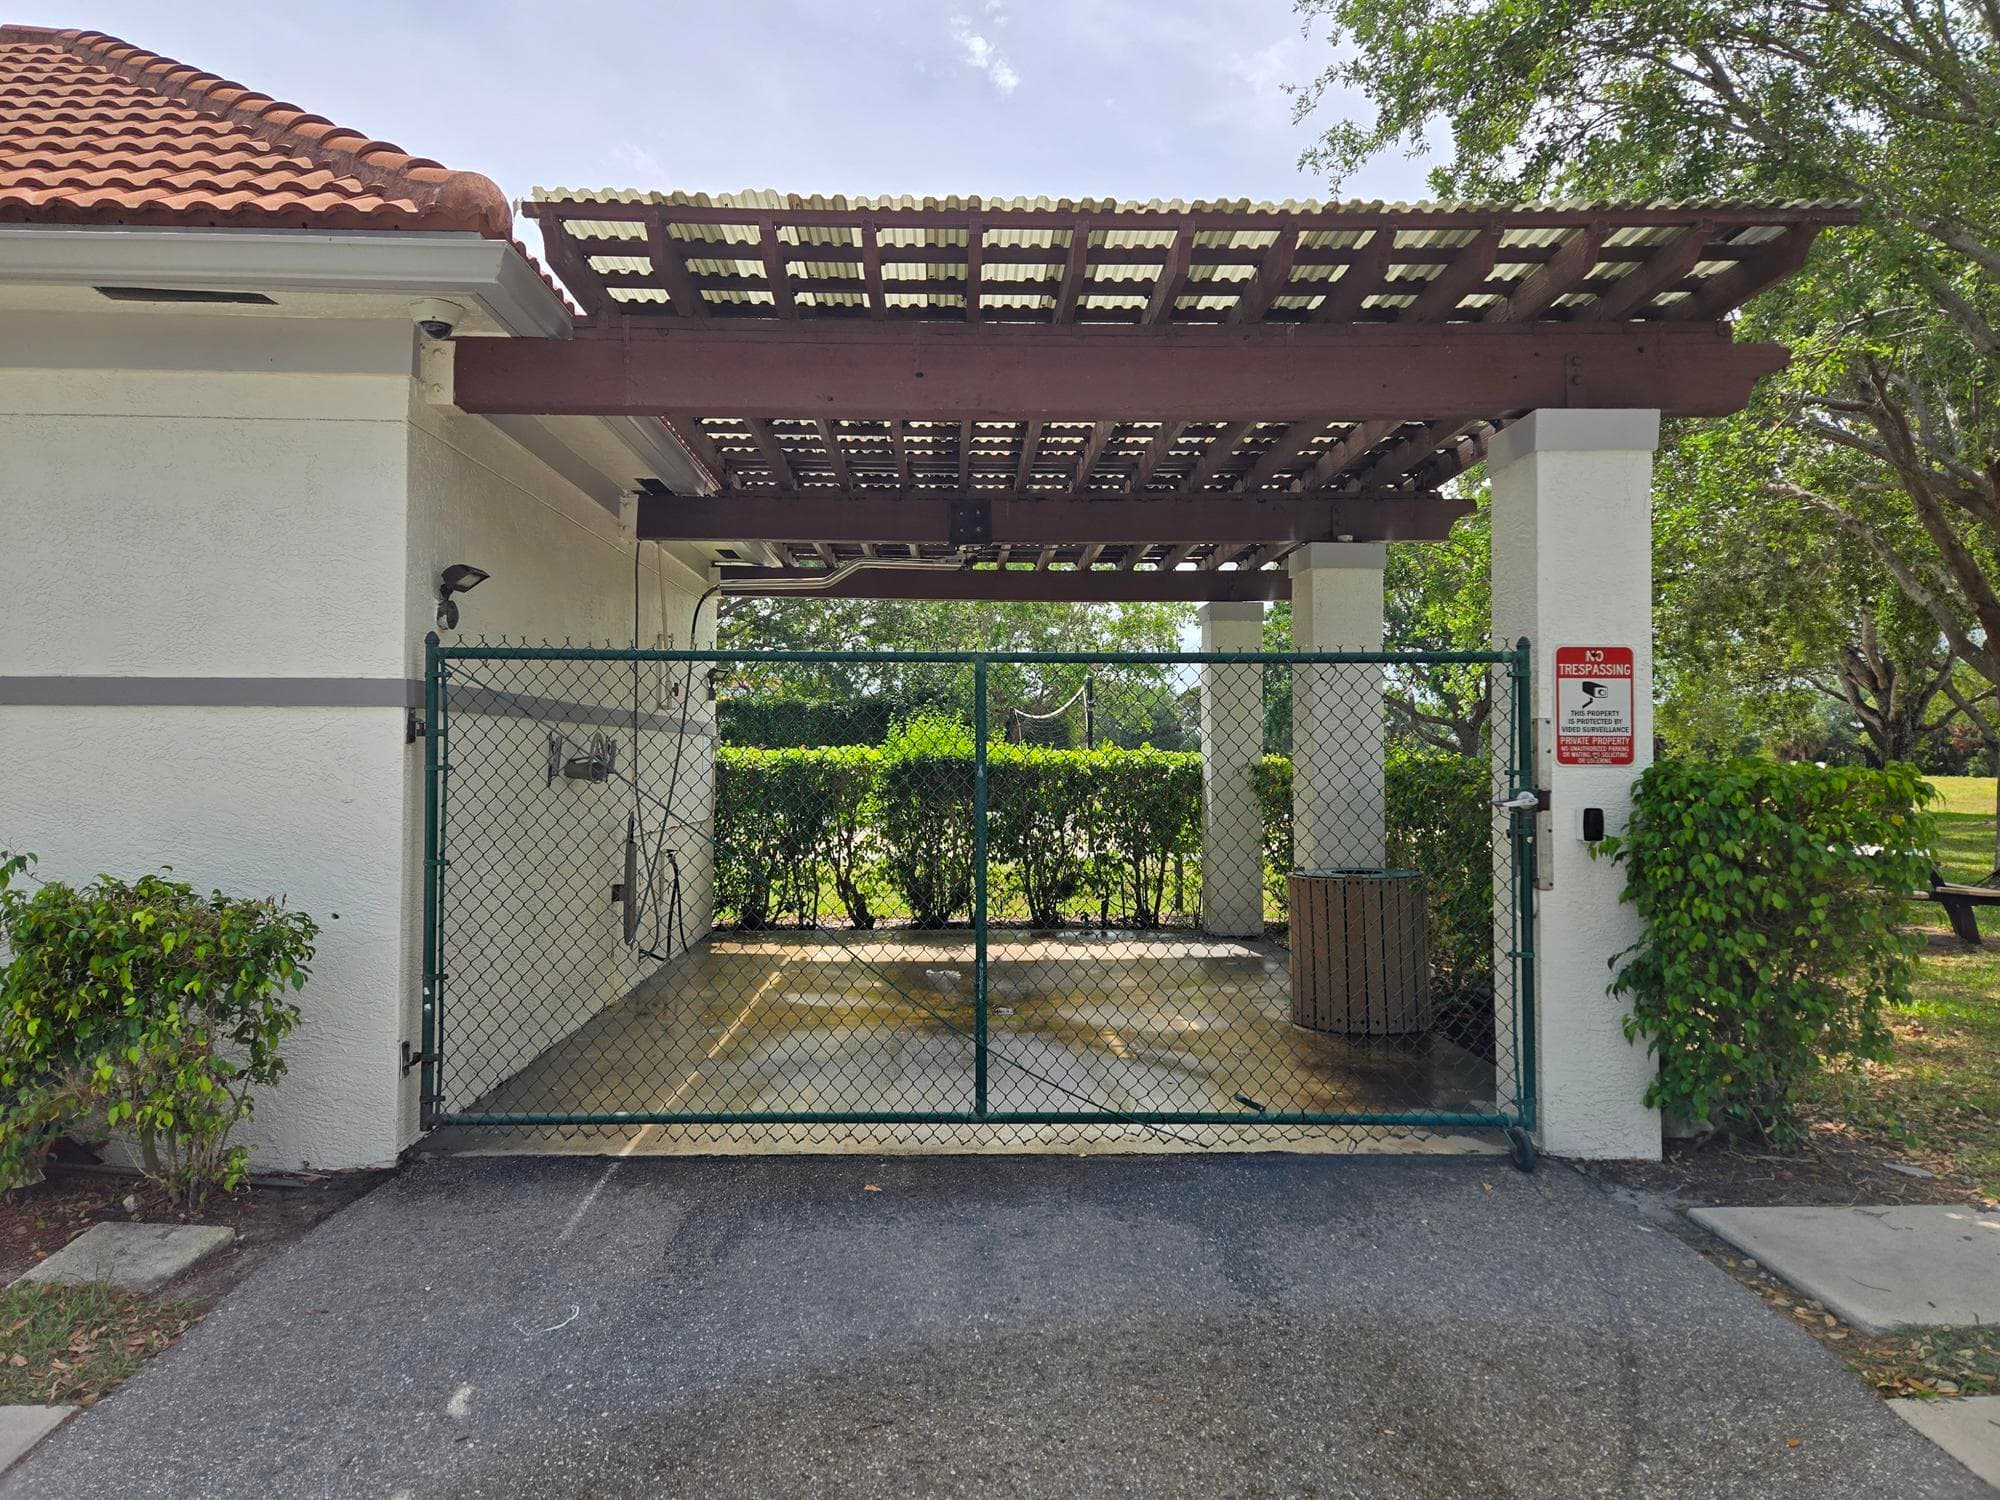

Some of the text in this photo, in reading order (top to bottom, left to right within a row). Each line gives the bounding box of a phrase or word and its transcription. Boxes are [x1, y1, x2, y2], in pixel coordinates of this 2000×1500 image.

[1585, 650, 1604, 662] NO
[1559, 664, 1631, 675] TRESPASSING
[1560, 737, 1630, 745] PRIVATE PROPERTY
